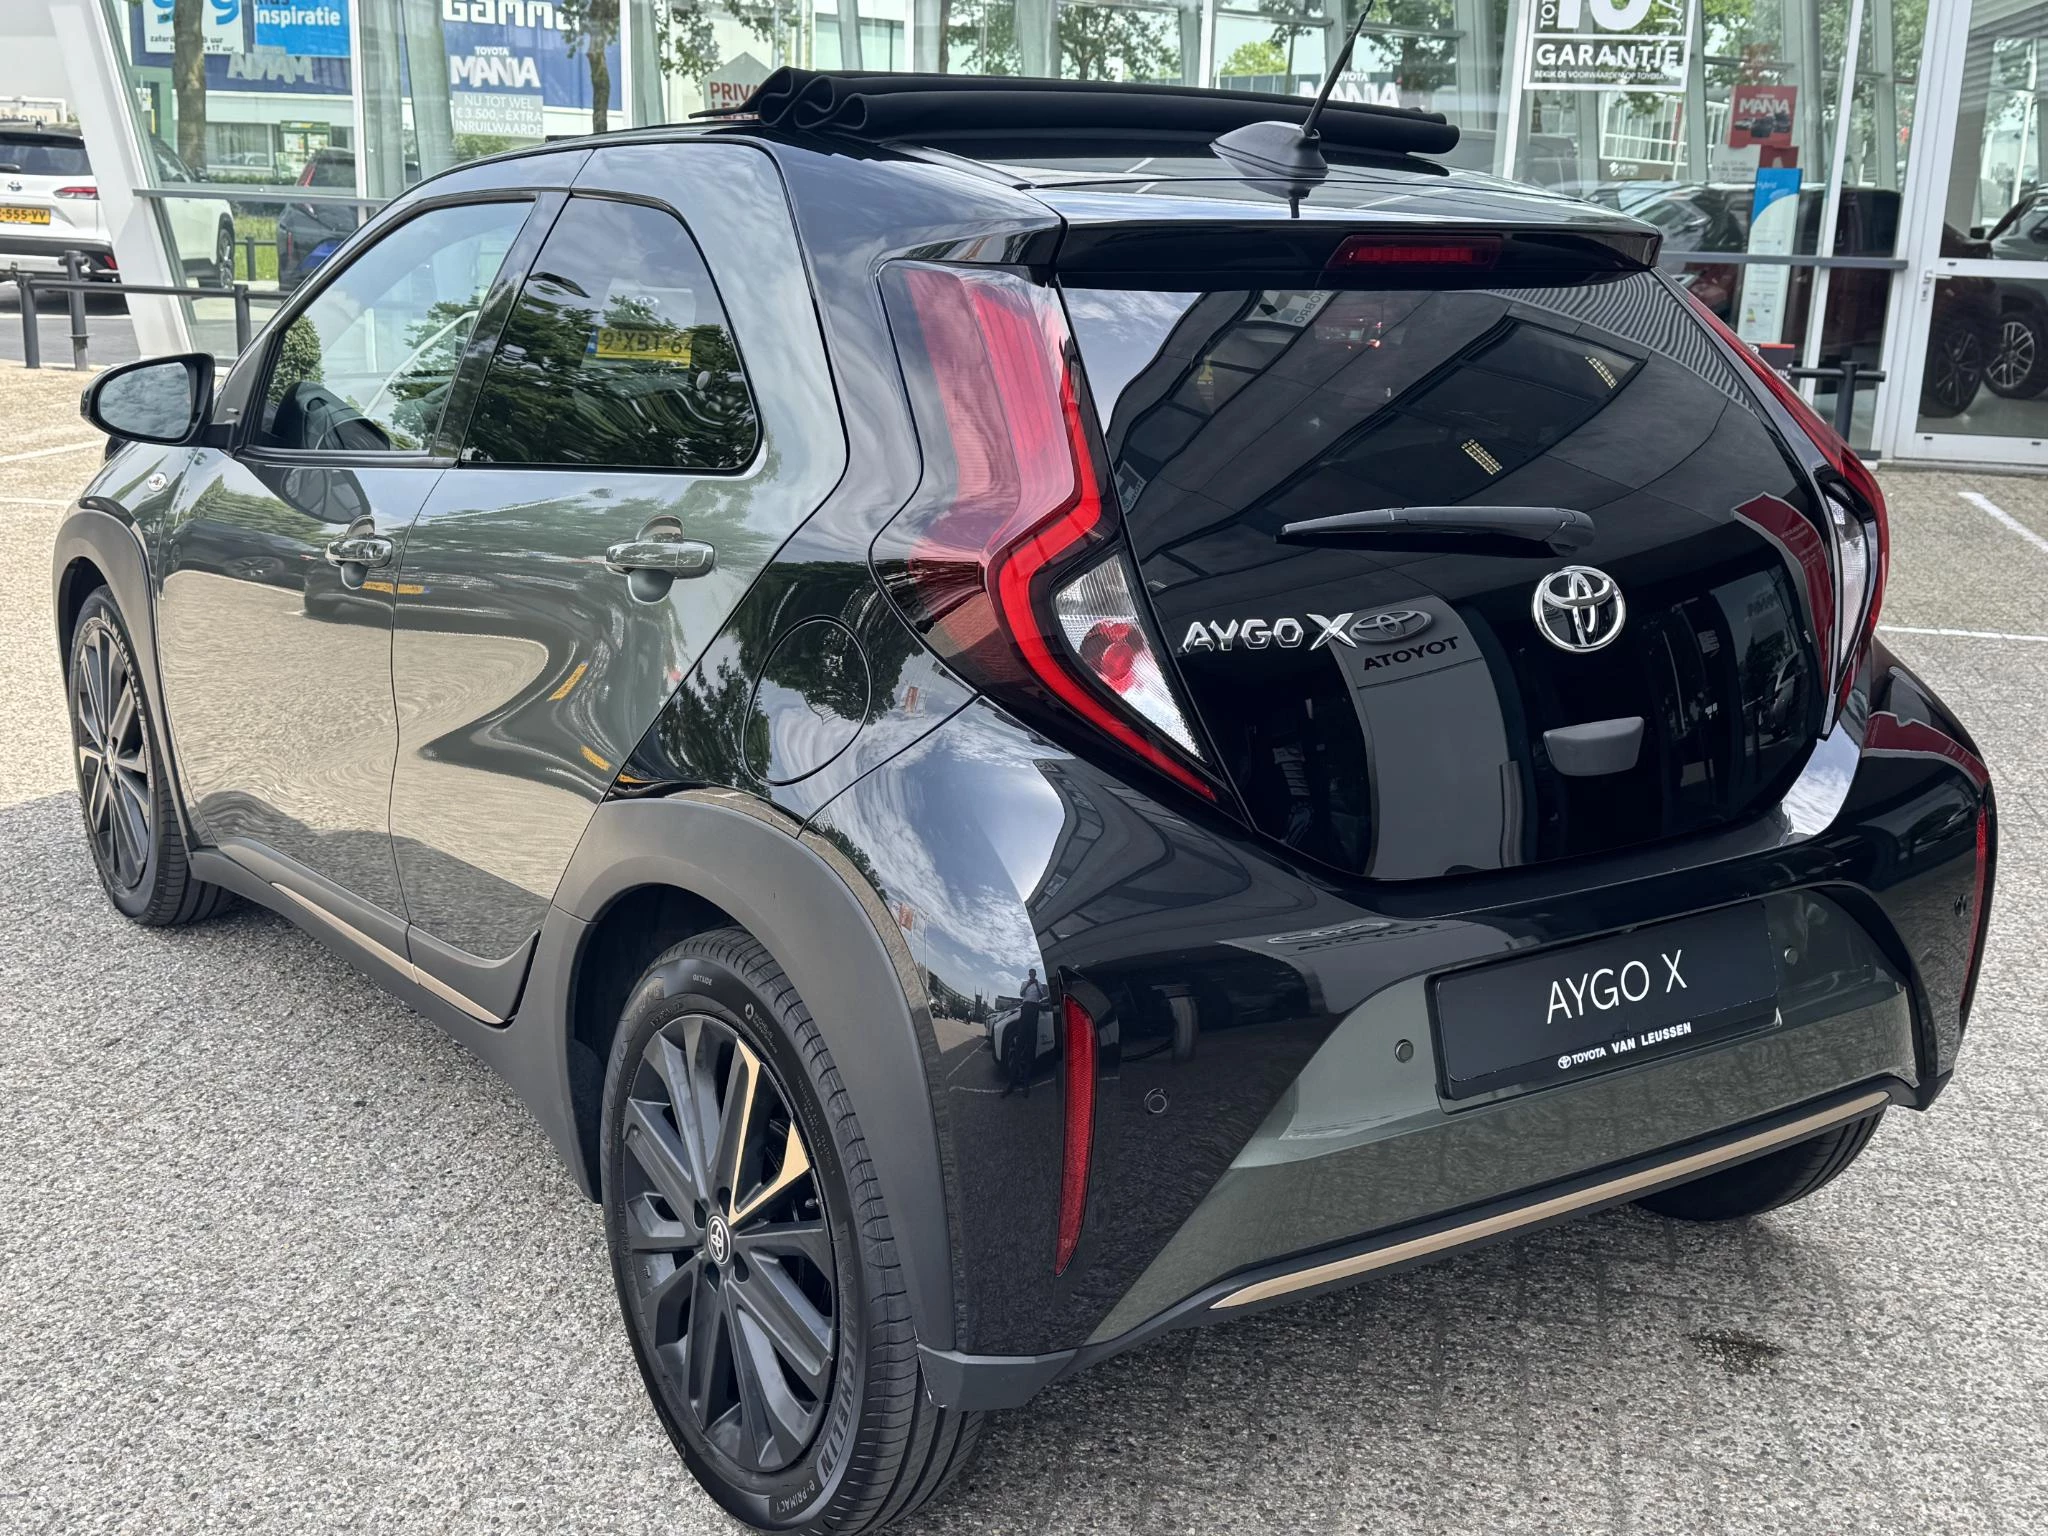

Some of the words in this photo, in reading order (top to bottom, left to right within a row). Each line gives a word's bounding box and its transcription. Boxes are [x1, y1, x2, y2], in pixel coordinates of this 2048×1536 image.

[254, 6, 341, 28] inspiratie
[474, 46, 510, 56] TOYOTA
[1536, 43, 1679, 69] GARANTIE
[450, 55, 541, 88] MANIA
[464, 95, 482, 106] NU
[485, 96, 507, 107] TOT
[509, 97, 534, 110] WEL
[506, 108, 542, 122] EXTRA
[455, 120, 543, 136] INRUILWAARDE
[1181, 618, 1304, 653] AYGO
[1307, 612, 1358, 650] X
[1546, 960, 1650, 1024] AYGO
[1662, 949, 1687, 993] X
[1572, 1047, 1606, 1065] TOYOTA
[1611, 1037, 1636, 1055] VAN
[1641, 1022, 1692, 1046] LEUSSEN
